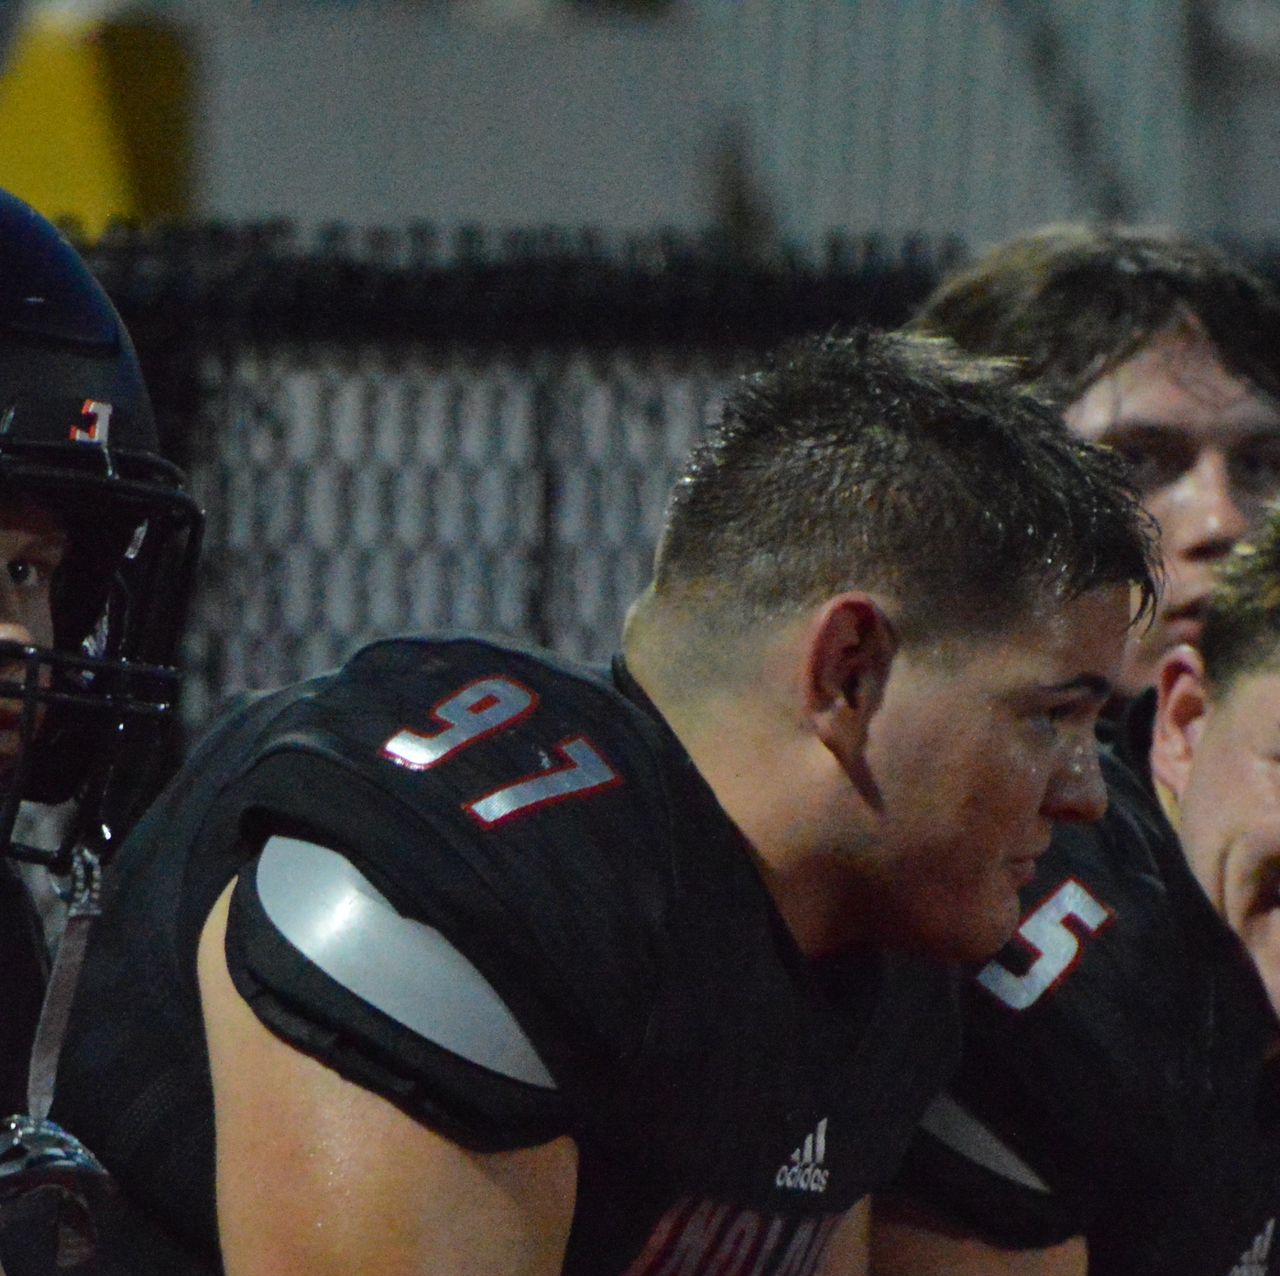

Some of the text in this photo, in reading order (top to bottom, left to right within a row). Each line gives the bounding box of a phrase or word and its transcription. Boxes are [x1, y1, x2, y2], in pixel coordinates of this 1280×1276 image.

[382, 675, 622, 829] 97
[974, 876, 1116, 1014] 5
[776, 1162, 830, 1192] adidas
